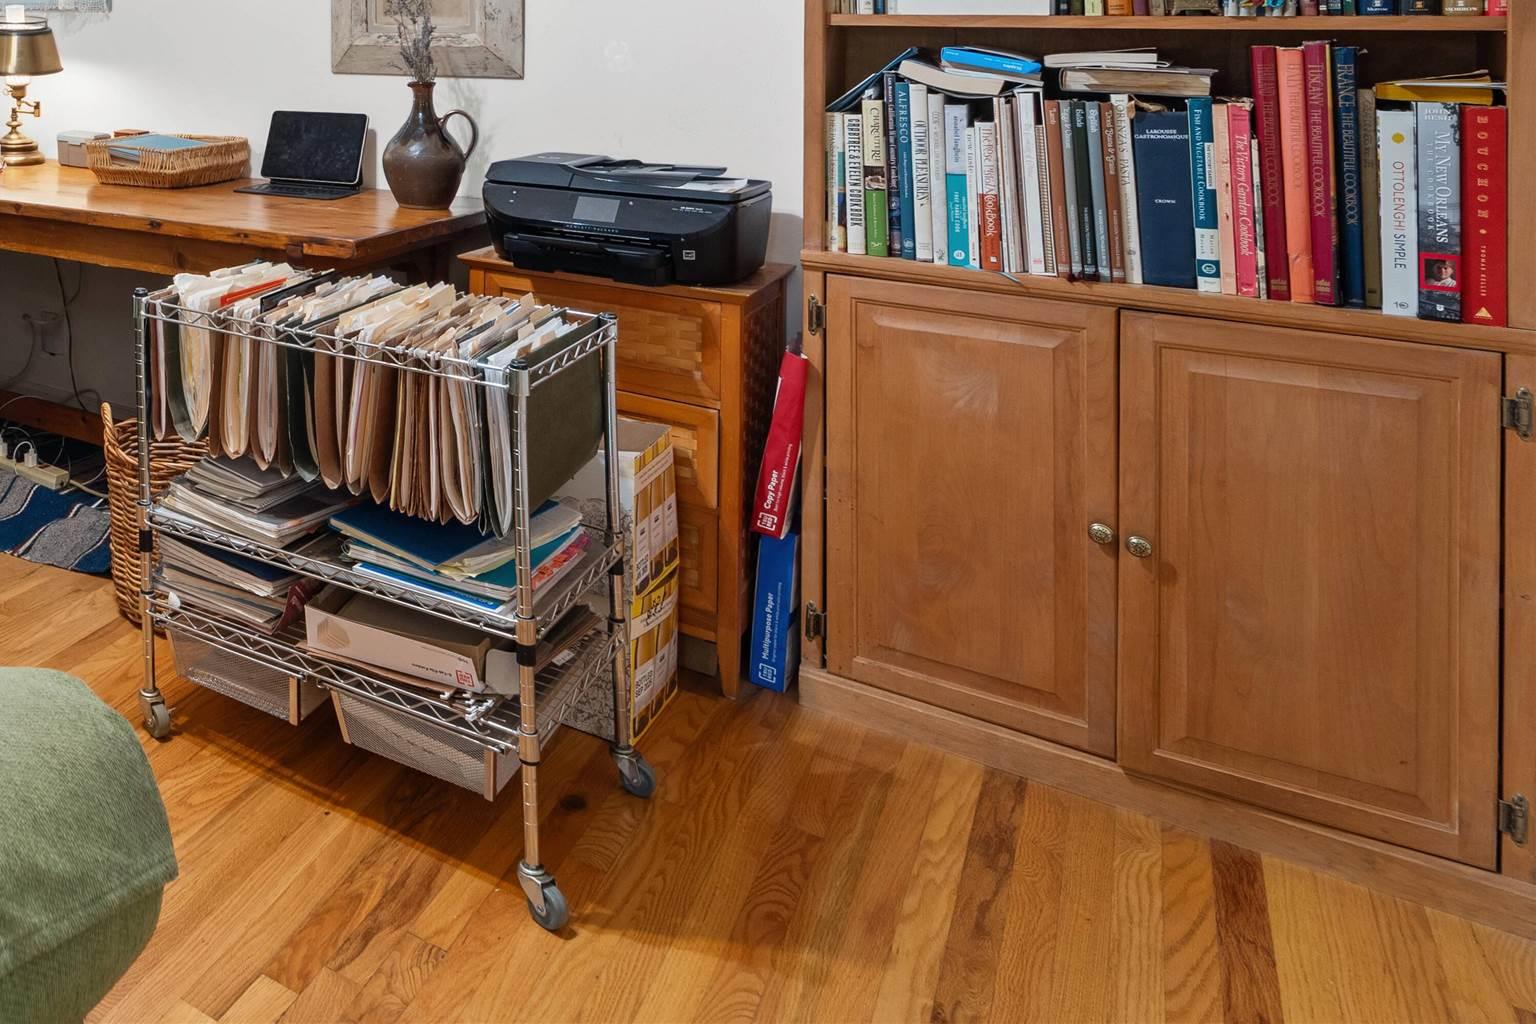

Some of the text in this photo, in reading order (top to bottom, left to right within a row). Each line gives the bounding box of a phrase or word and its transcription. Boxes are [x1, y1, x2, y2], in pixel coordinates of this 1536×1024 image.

[848, 118, 859, 153] CRABTREE
[898, 91, 908, 143] ALFRESCO
[1337, 63, 1358, 225] FRANCE THE BEAUTIFUL COOKBOOK
[848, 161, 861, 187] EVELYN
[1194, 109, 1206, 221] FISH AND VEGETABLE COOKBOOK
[1235, 134, 1252, 256] The Victory Garden Cookbook
[1435, 131, 1451, 243] MY NEW ORLEANS
[1477, 115, 1489, 218] BOUCHON
[849, 189, 863, 227] COOKBOOK
[1392, 161, 1406, 269] OTTOLENGHI SIMPLE
[1480, 274, 1488, 297] KELLER
[764, 470, 778, 509] Copy Paper
[761, 592, 774, 659] Multipurpose Paper
